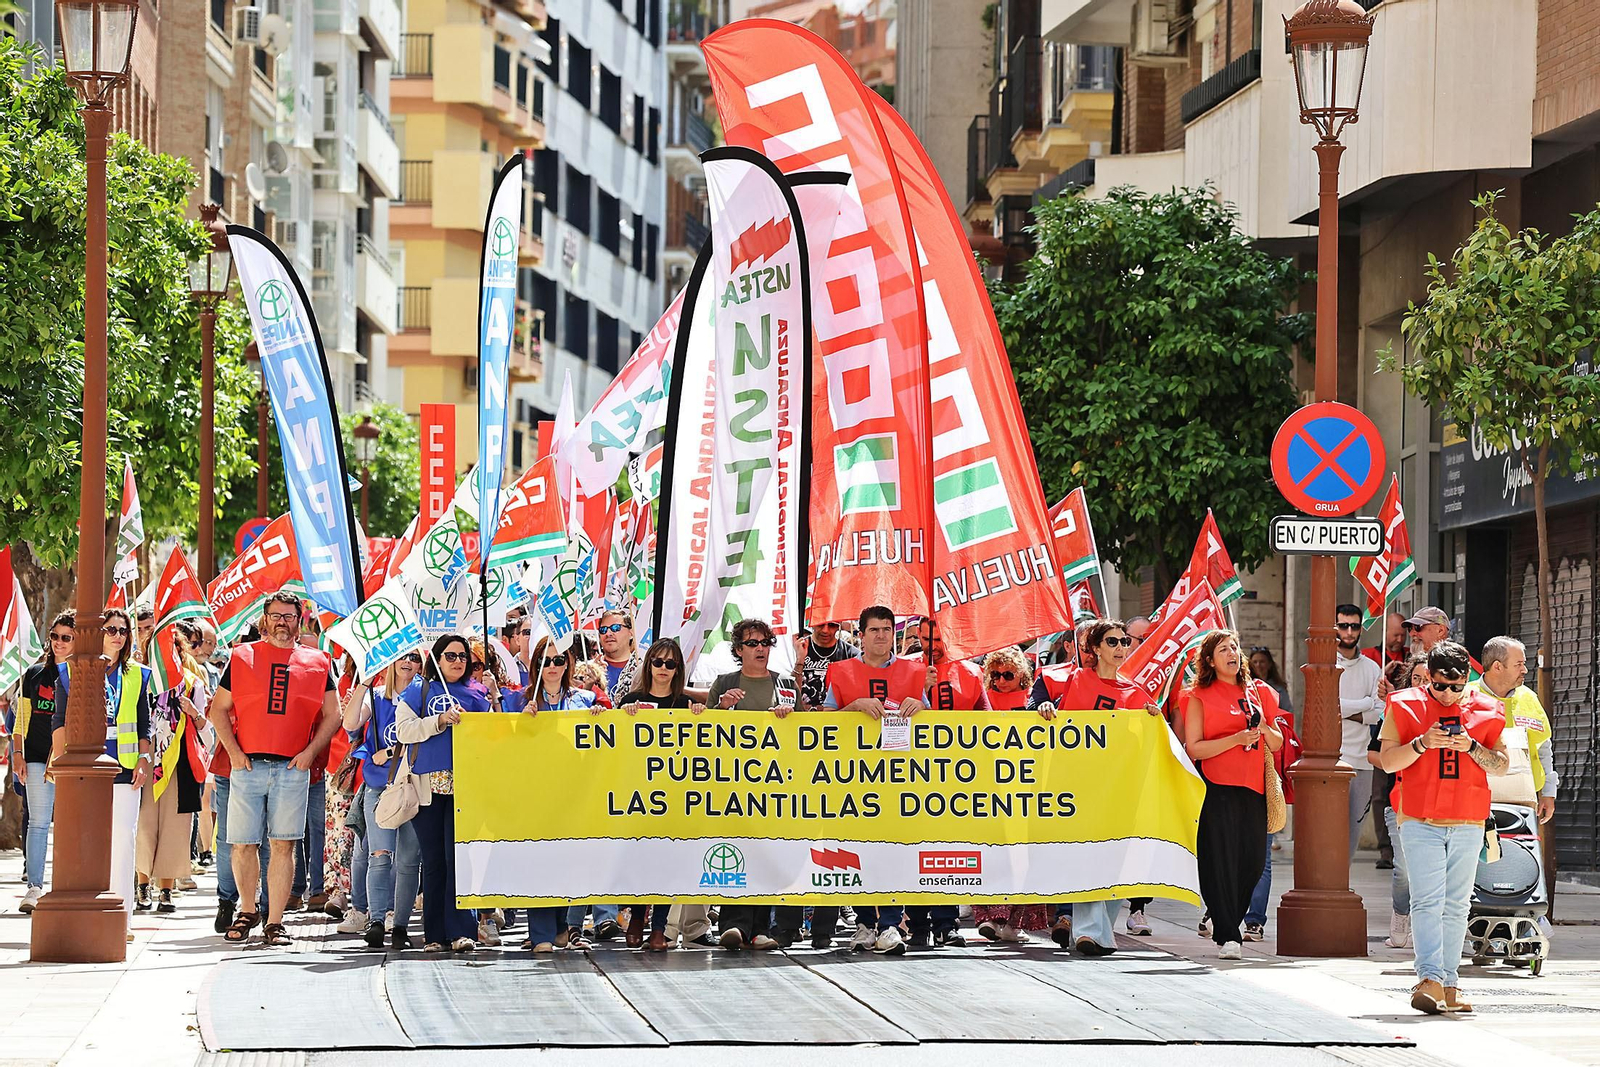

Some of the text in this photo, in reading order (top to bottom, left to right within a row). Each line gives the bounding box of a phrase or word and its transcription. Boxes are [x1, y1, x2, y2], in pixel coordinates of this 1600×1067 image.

[1315, 503, 1340, 512] GRUA
[1276, 525, 1379, 545] EN C/ PUERTO
[413, 609, 458, 628] NPE
[540, 583, 573, 640] NPE
[364, 622, 423, 672] ANPE
[272, 666, 287, 712] CCOO
[575, 724, 615, 749] EN
[635, 724, 780, 750] DEFENSA
[799, 726, 839, 750] DE
[914, 718, 1107, 750] EDUCACIÓN
[647, 750, 1036, 785] PÚBLICA: AUMENTO DE
[608, 790, 1077, 819] LAS PLANTILLAS DOCENTES
[699, 872, 746, 885] ANPE
[811, 873, 863, 887] USTEA
[919, 874, 982, 886] enseñanza
